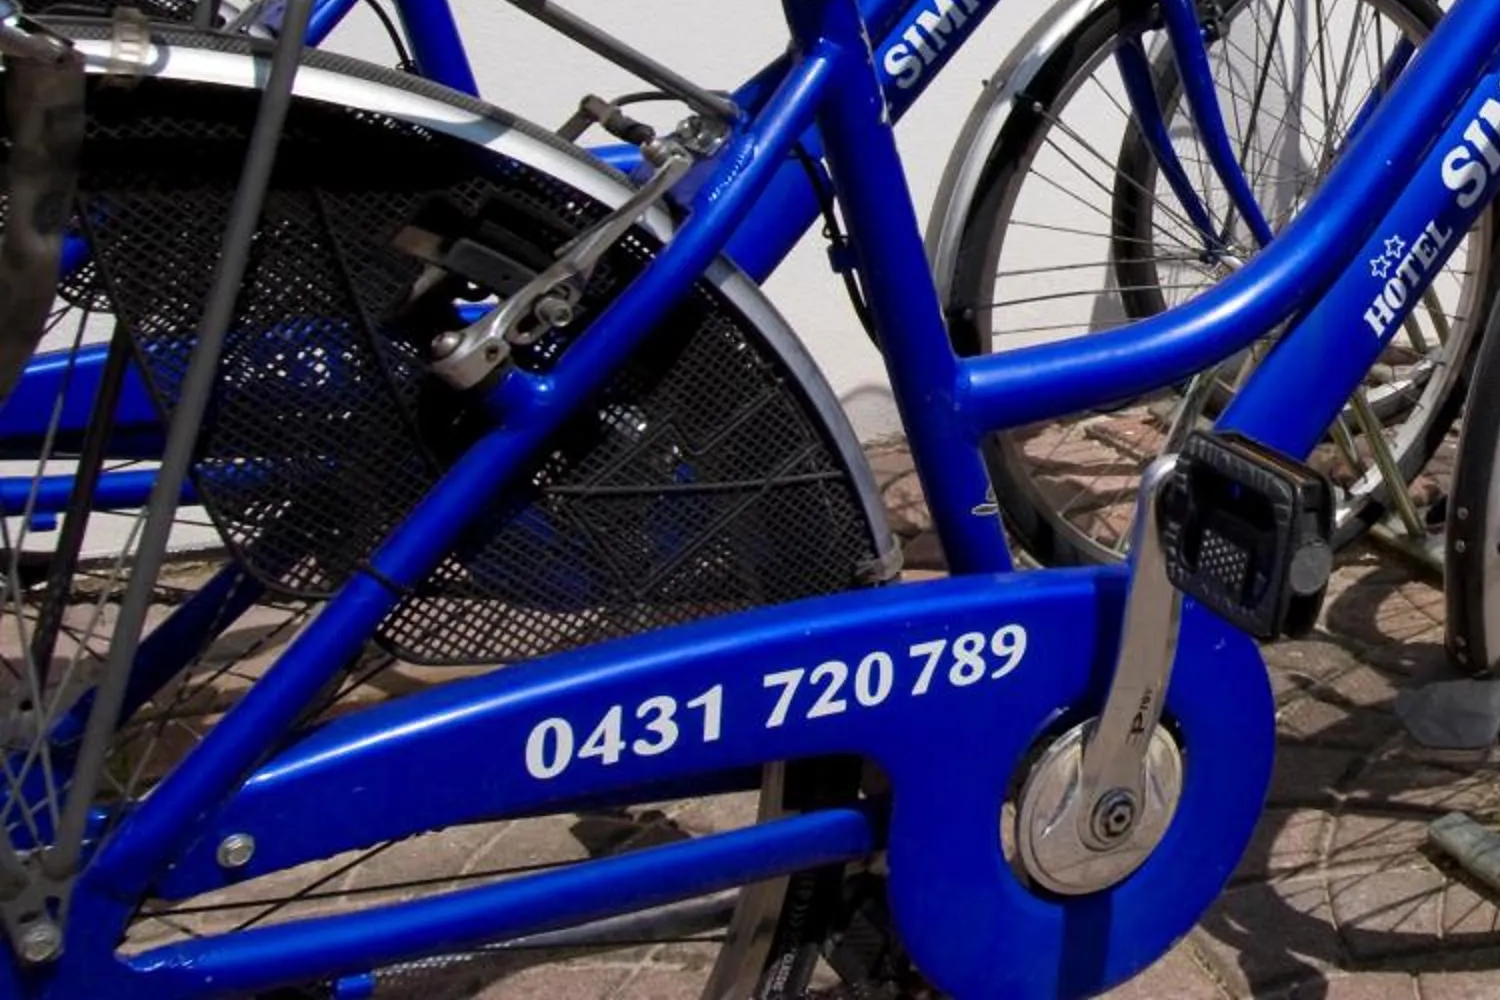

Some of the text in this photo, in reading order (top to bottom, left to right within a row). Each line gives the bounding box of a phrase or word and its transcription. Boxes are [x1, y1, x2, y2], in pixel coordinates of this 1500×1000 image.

[1363, 218, 1454, 339] HOTEL
[525, 623, 1028, 780] 0431 720 789
